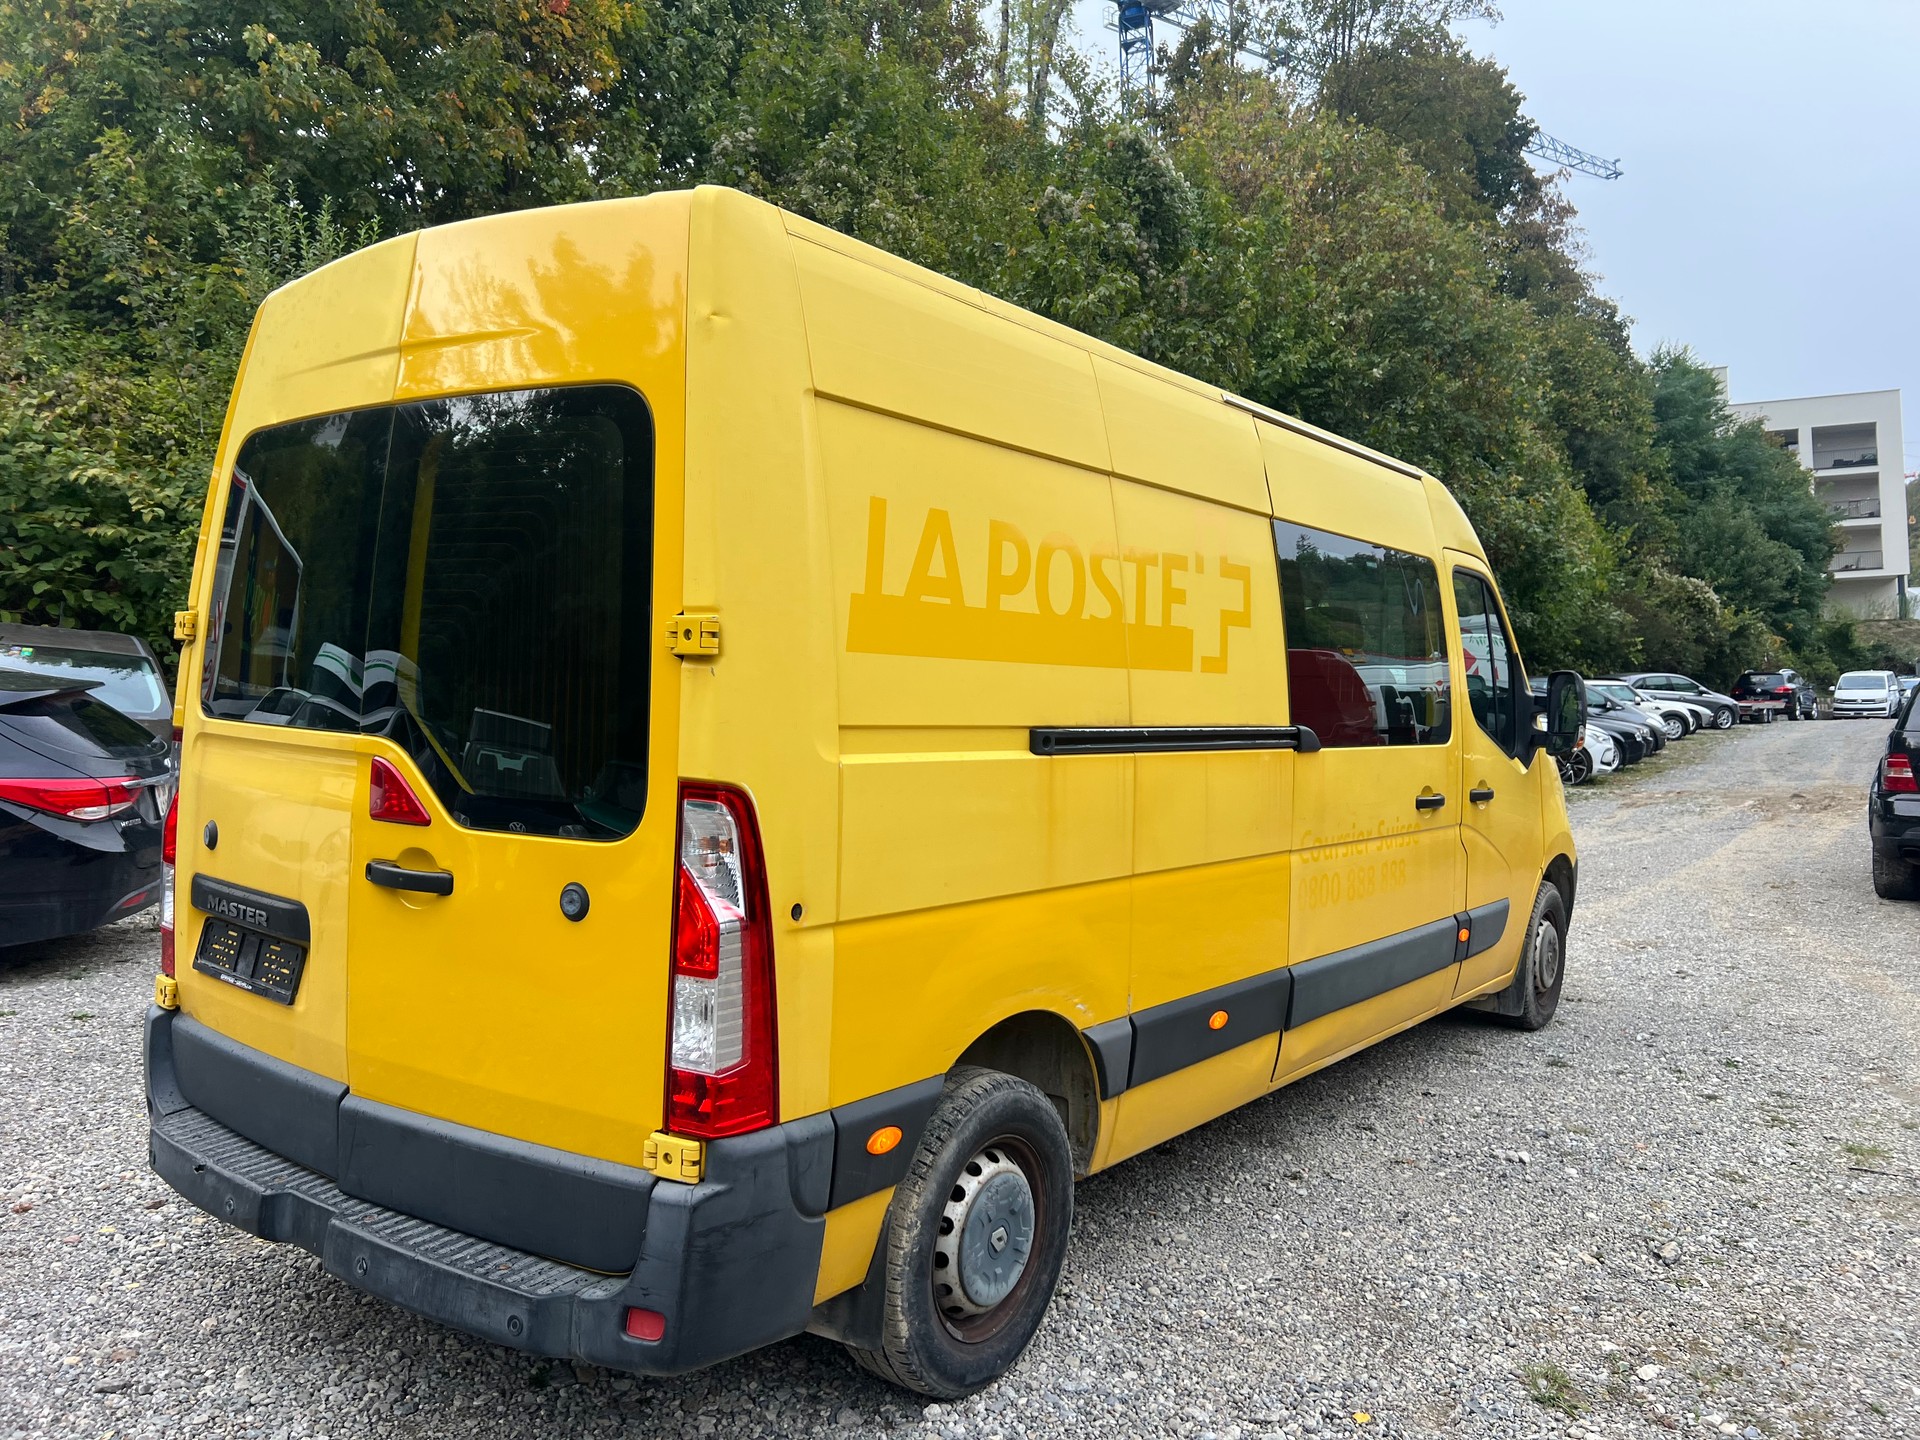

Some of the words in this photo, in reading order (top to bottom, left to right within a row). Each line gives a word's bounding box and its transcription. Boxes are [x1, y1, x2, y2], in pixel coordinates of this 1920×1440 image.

[864, 495, 966, 609] LA
[985, 518, 1190, 627] POSTE
[1299, 822, 1372, 865] Coursier
[1376, 817, 1422, 852] Suisse
[207, 894, 268, 927] MASTER
